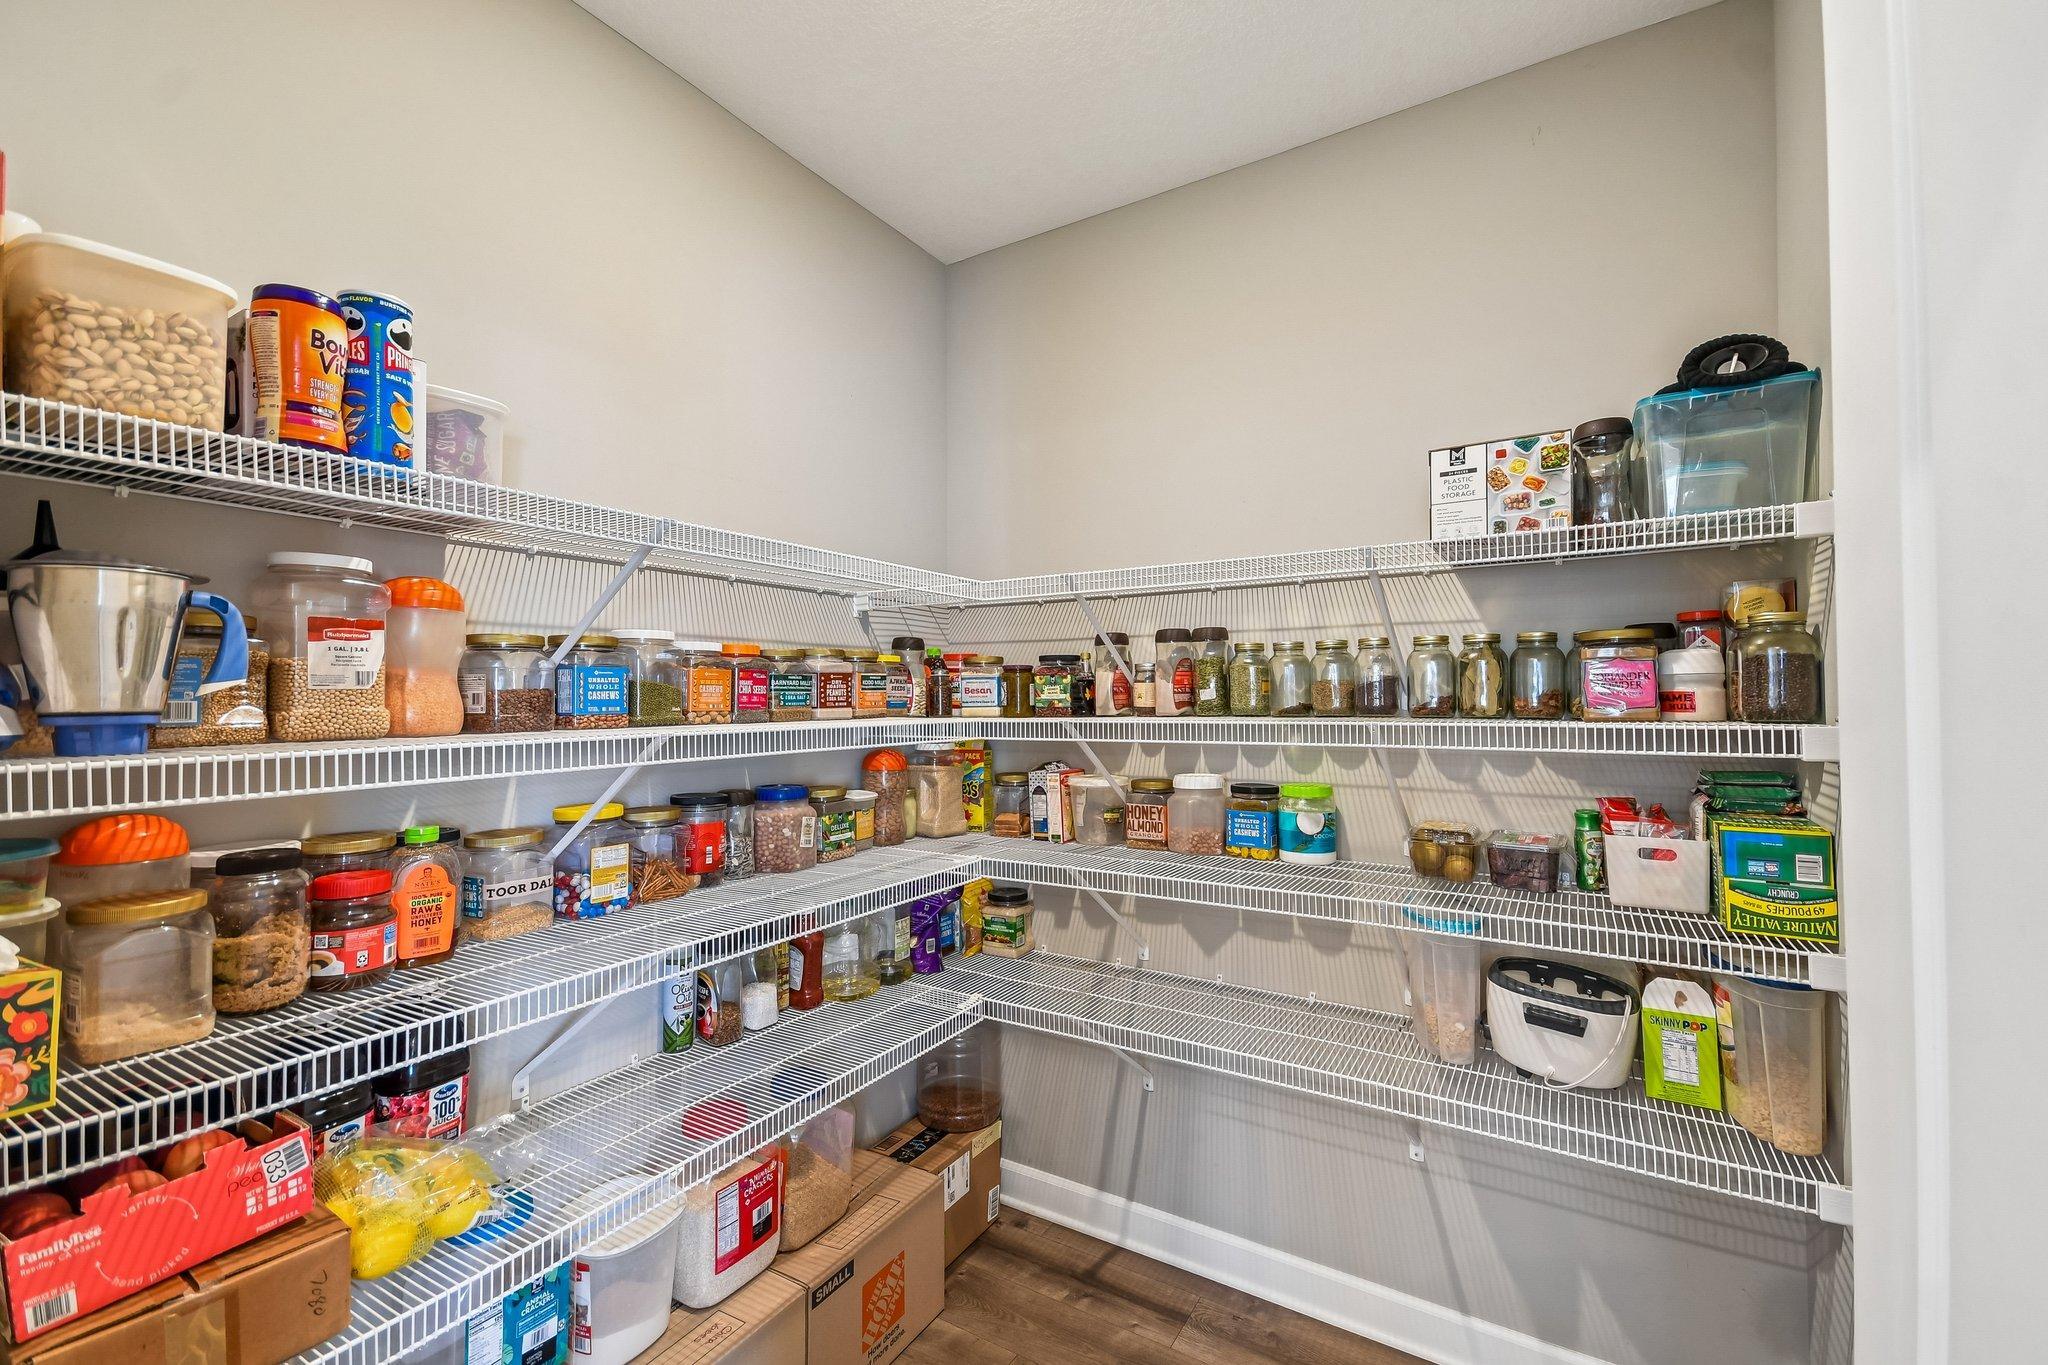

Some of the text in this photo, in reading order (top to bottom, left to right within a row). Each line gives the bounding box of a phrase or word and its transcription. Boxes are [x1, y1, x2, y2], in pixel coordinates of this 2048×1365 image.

[385, 373, 402, 382] SALT
[436, 413, 456, 454] SUGAR
[1444, 476, 1474, 485] PLASTIC
[1447, 483, 1470, 492] FOOD
[1441, 490, 1476, 500] STORAGE
[326, 630, 370, 640] Rubbermaid
[699, 684, 723, 693] CASHEWS
[738, 685, 767, 695] CHIA SEEDS
[826, 689, 847, 697] PEANUTS
[588, 690, 620, 700] CASHEWS
[964, 752, 982, 760] PACK
[1126, 804, 1164, 821] HONEY
[830, 822, 850, 832] DELUXE
[1127, 820, 1164, 834] ALMOND
[1234, 829, 1260, 838] CASHEWS
[414, 880, 441, 888] NATE'S
[486, 883, 526, 898] TOOR
[530, 878, 554, 890] DAL
[1767, 888, 1800, 900] CRUNCHY
[410, 897, 444, 907] ORGANIC
[410, 904, 442, 916] RAW &
[410, 911, 443, 920] UNFILTERED
[1766, 904, 1812, 916] POUCHES
[1814, 906, 1826, 916] 49
[410, 916, 443, 928] HONEY
[1732, 909, 1838, 937] NATURE VALLEY
[676, 992, 692, 1004] Oil
[1682, 1020, 1708, 1032] POP
[432, 1113, 459, 1127] JUICE
[264, 1150, 287, 1184] 033
[748, 1167, 770, 1187] ANIMAL
[744, 1173, 774, 1198] CRACKERS
[278, 1193, 286, 1202] 10
[298, 1184, 307, 1193] 12
[120, 1194, 168, 1218] variety
[18, 1226, 103, 1267] FamilyTree
[20, 1260, 56, 1278] Reedley,
[58, 1250, 73, 1263] CA
[113, 1247, 190, 1289] hand picked
[816, 1267, 851, 1303] SMALL
[520, 1293, 554, 1317] CRACKERS
[526, 1290, 550, 1308] ANIMAL
[862, 1256, 904, 1345] HOME
[879, 1276, 904, 1334] DEPOT
[867, 1324, 900, 1358] How doers
[872, 1343, 889, 1363] more
